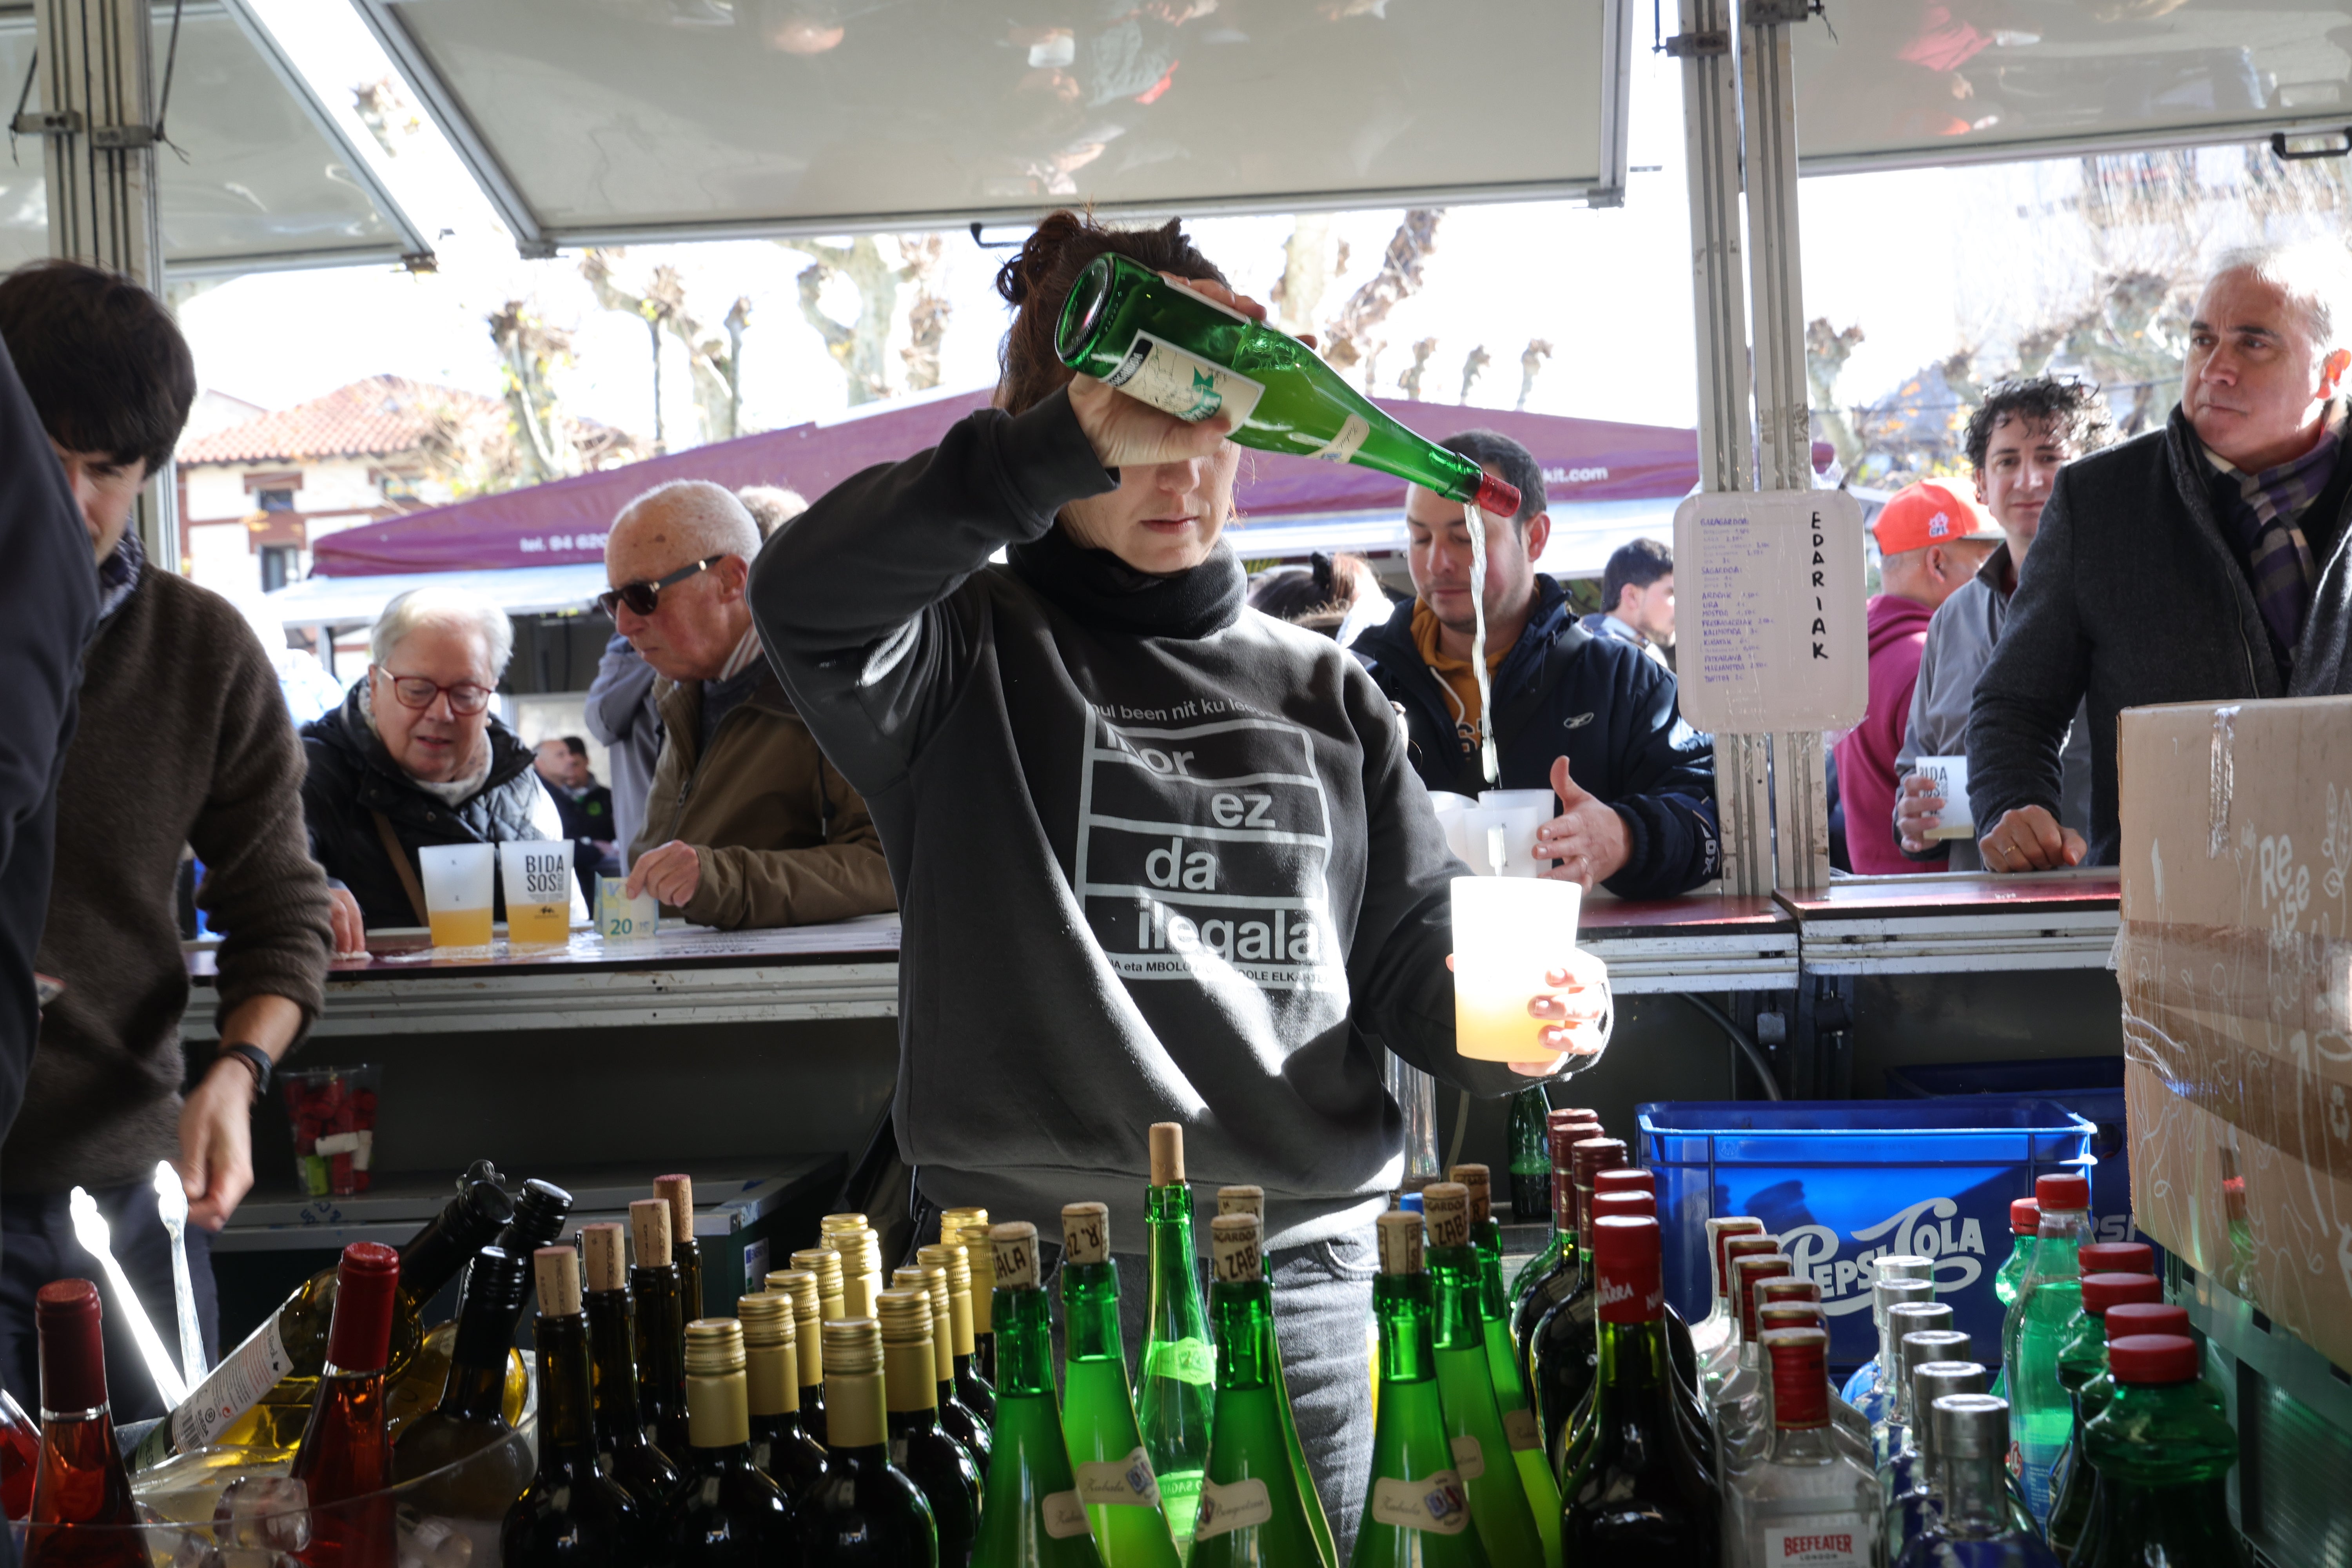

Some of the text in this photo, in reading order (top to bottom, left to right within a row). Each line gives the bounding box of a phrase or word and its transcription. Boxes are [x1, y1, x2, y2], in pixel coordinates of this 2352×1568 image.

[1811, 510, 1829, 660] EDARIAK
[1120, 705, 1167, 721] been
[1172, 700, 1198, 720] nit
[1201, 698, 1225, 715] ku
[1212, 792, 1275, 829] ez
[526, 854, 564, 873] BIDA
[1145, 837, 1217, 890] da
[527, 873, 556, 892] SOS
[610, 918, 633, 935] 20
[1124, 962, 1142, 971] eta
[1784, 1534, 1853, 1557] BEEFEATER
[1799, 1553, 1839, 1562] LONDON
